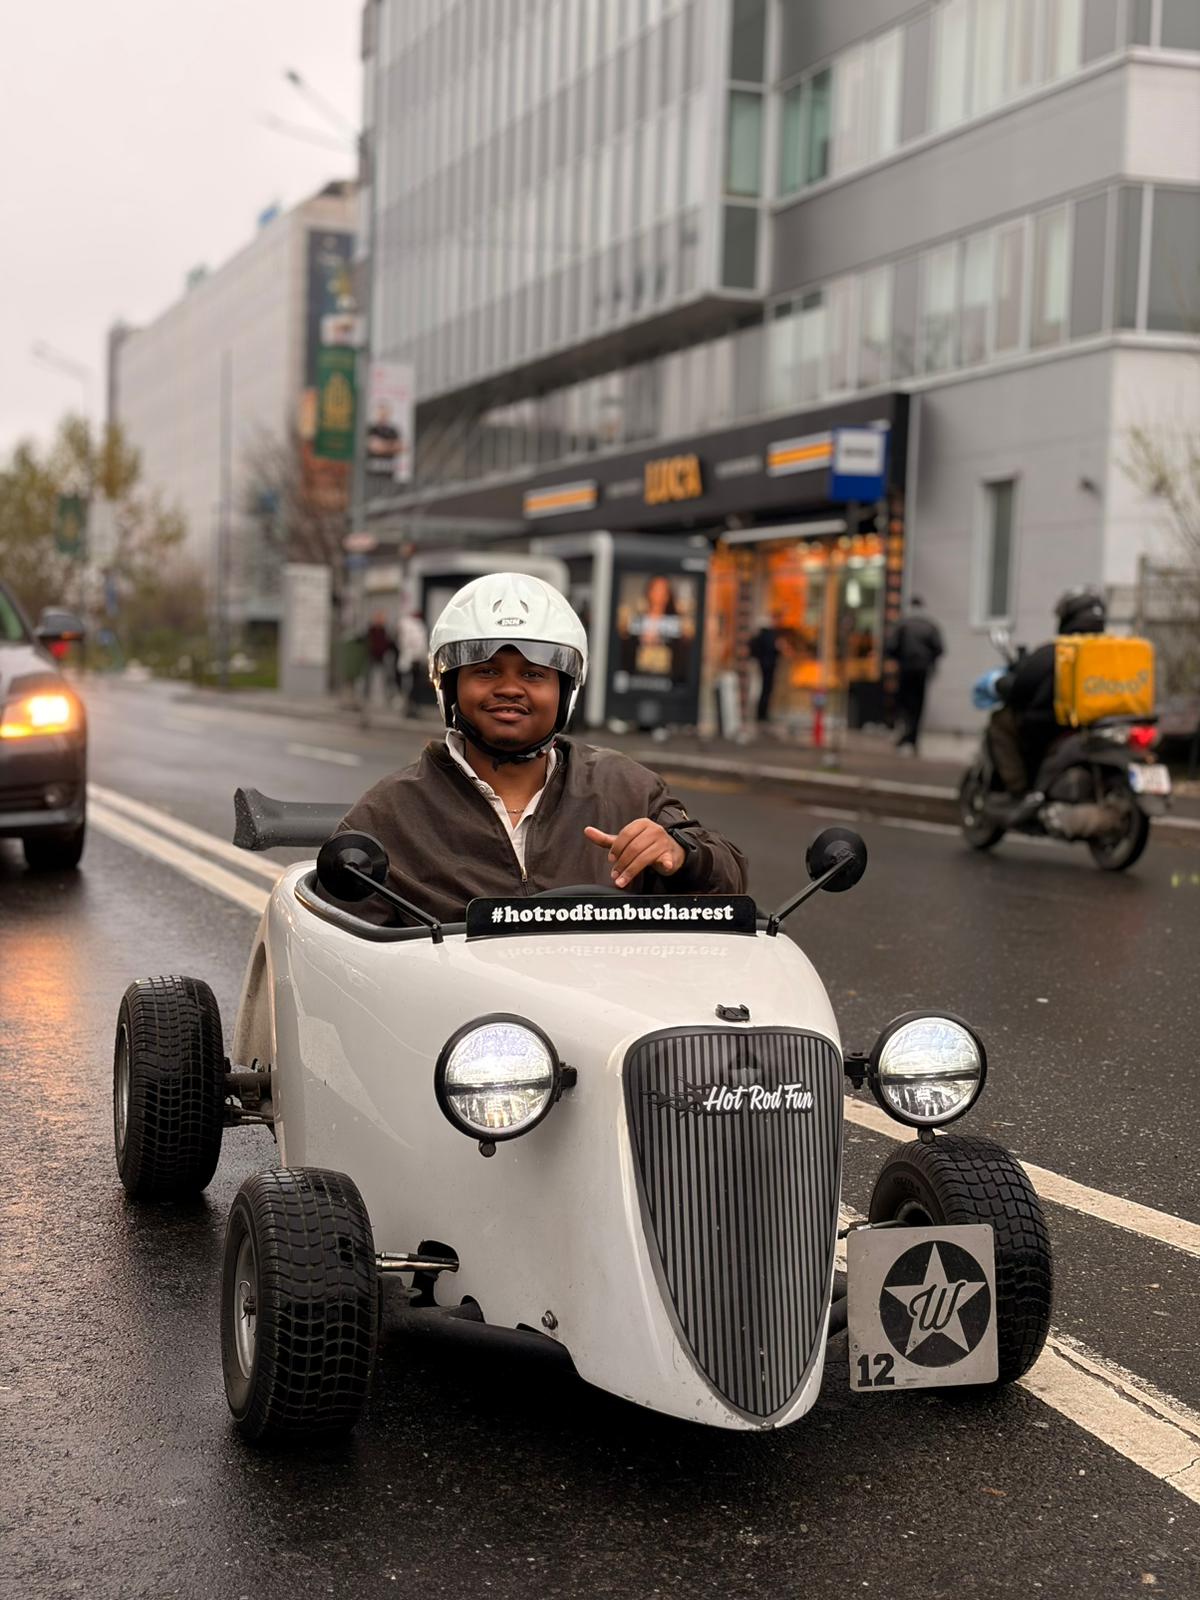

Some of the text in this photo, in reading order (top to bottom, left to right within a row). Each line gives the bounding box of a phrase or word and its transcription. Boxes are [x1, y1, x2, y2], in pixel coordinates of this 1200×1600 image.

[491, 903, 734, 923] #hotrodfunbucharest
[703, 1083, 813, 1111] Hot Rod Fun
[857, 1353, 895, 1388] 12
